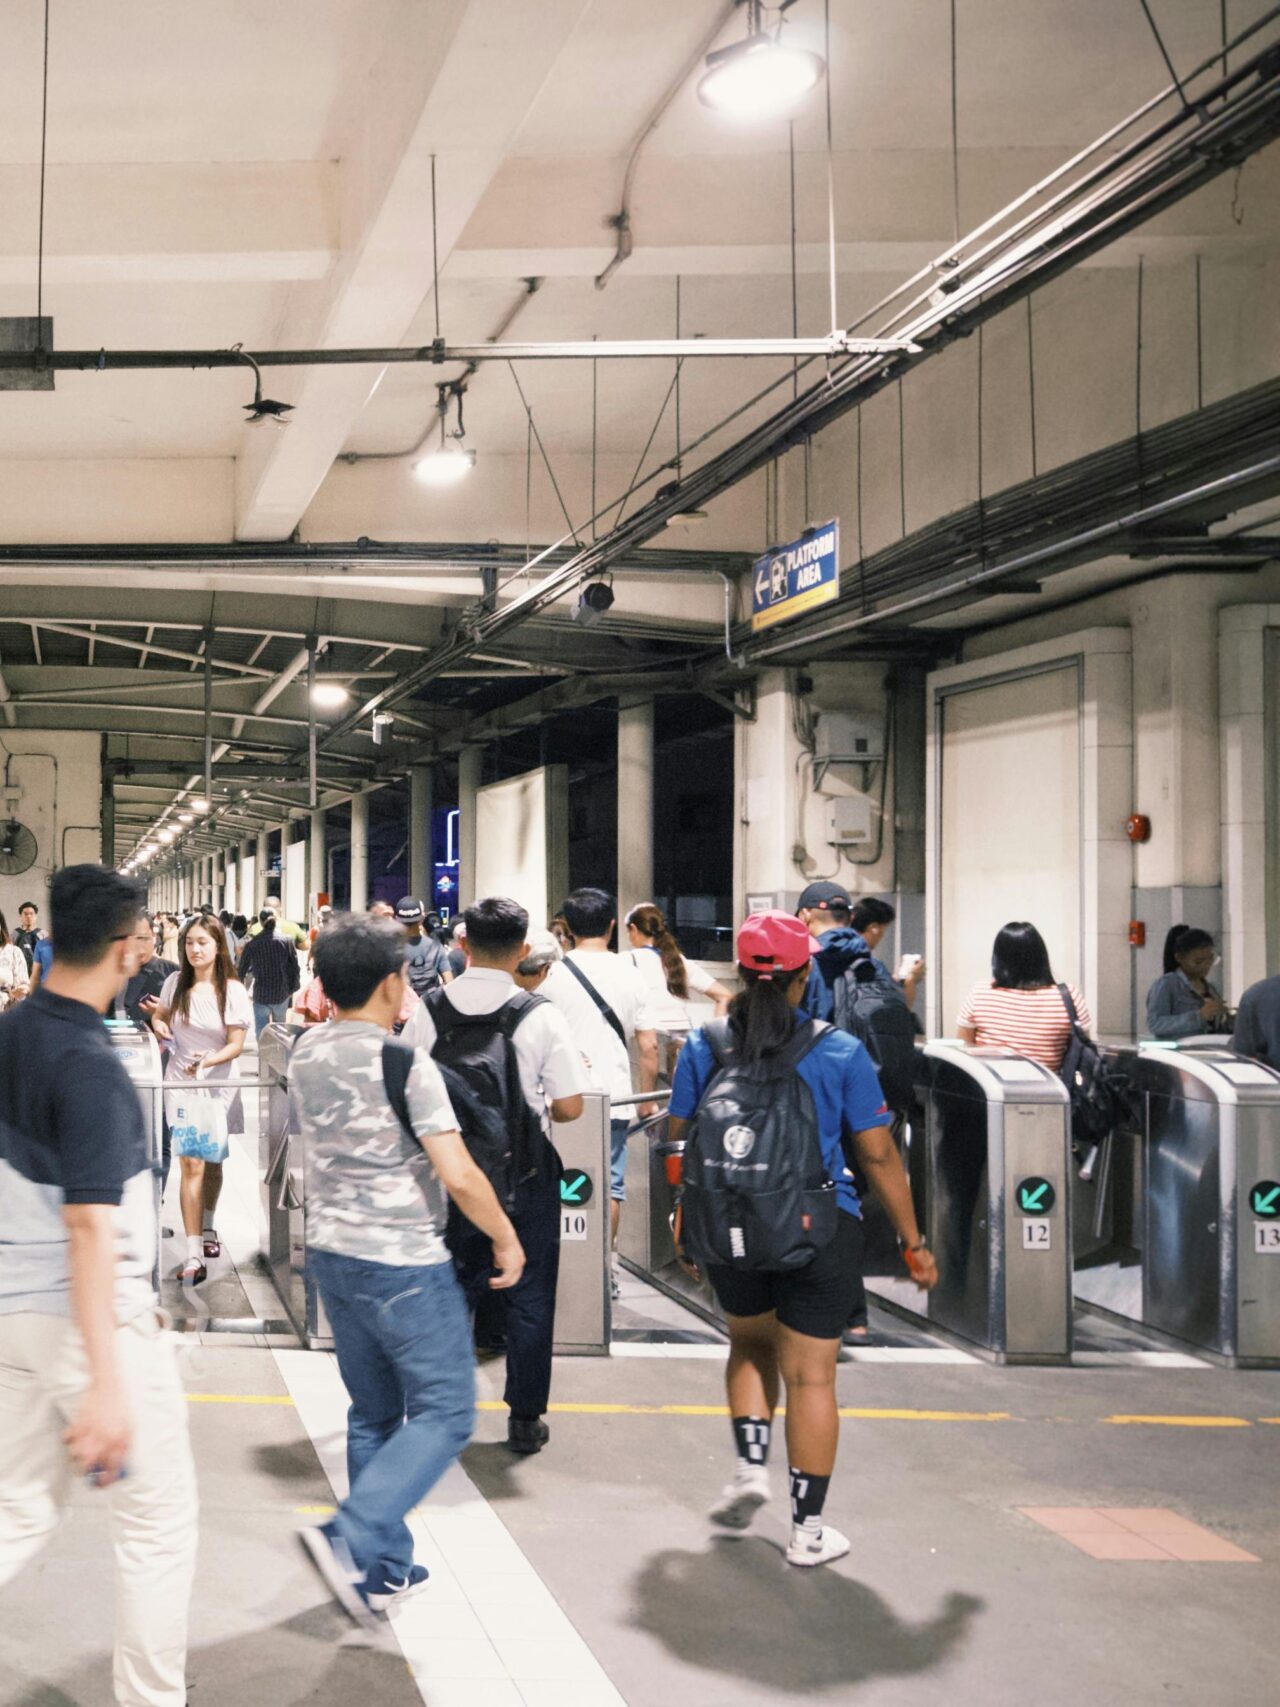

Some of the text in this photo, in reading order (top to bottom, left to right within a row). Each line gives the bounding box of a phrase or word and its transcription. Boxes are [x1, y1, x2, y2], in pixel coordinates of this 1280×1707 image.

[787, 531, 835, 572] PLATFORM
[797, 561, 822, 591] AREA
[564, 1216, 585, 1233] 10
[1026, 1224, 1048, 1242] 12
[1260, 1229, 1280, 1246] 13
